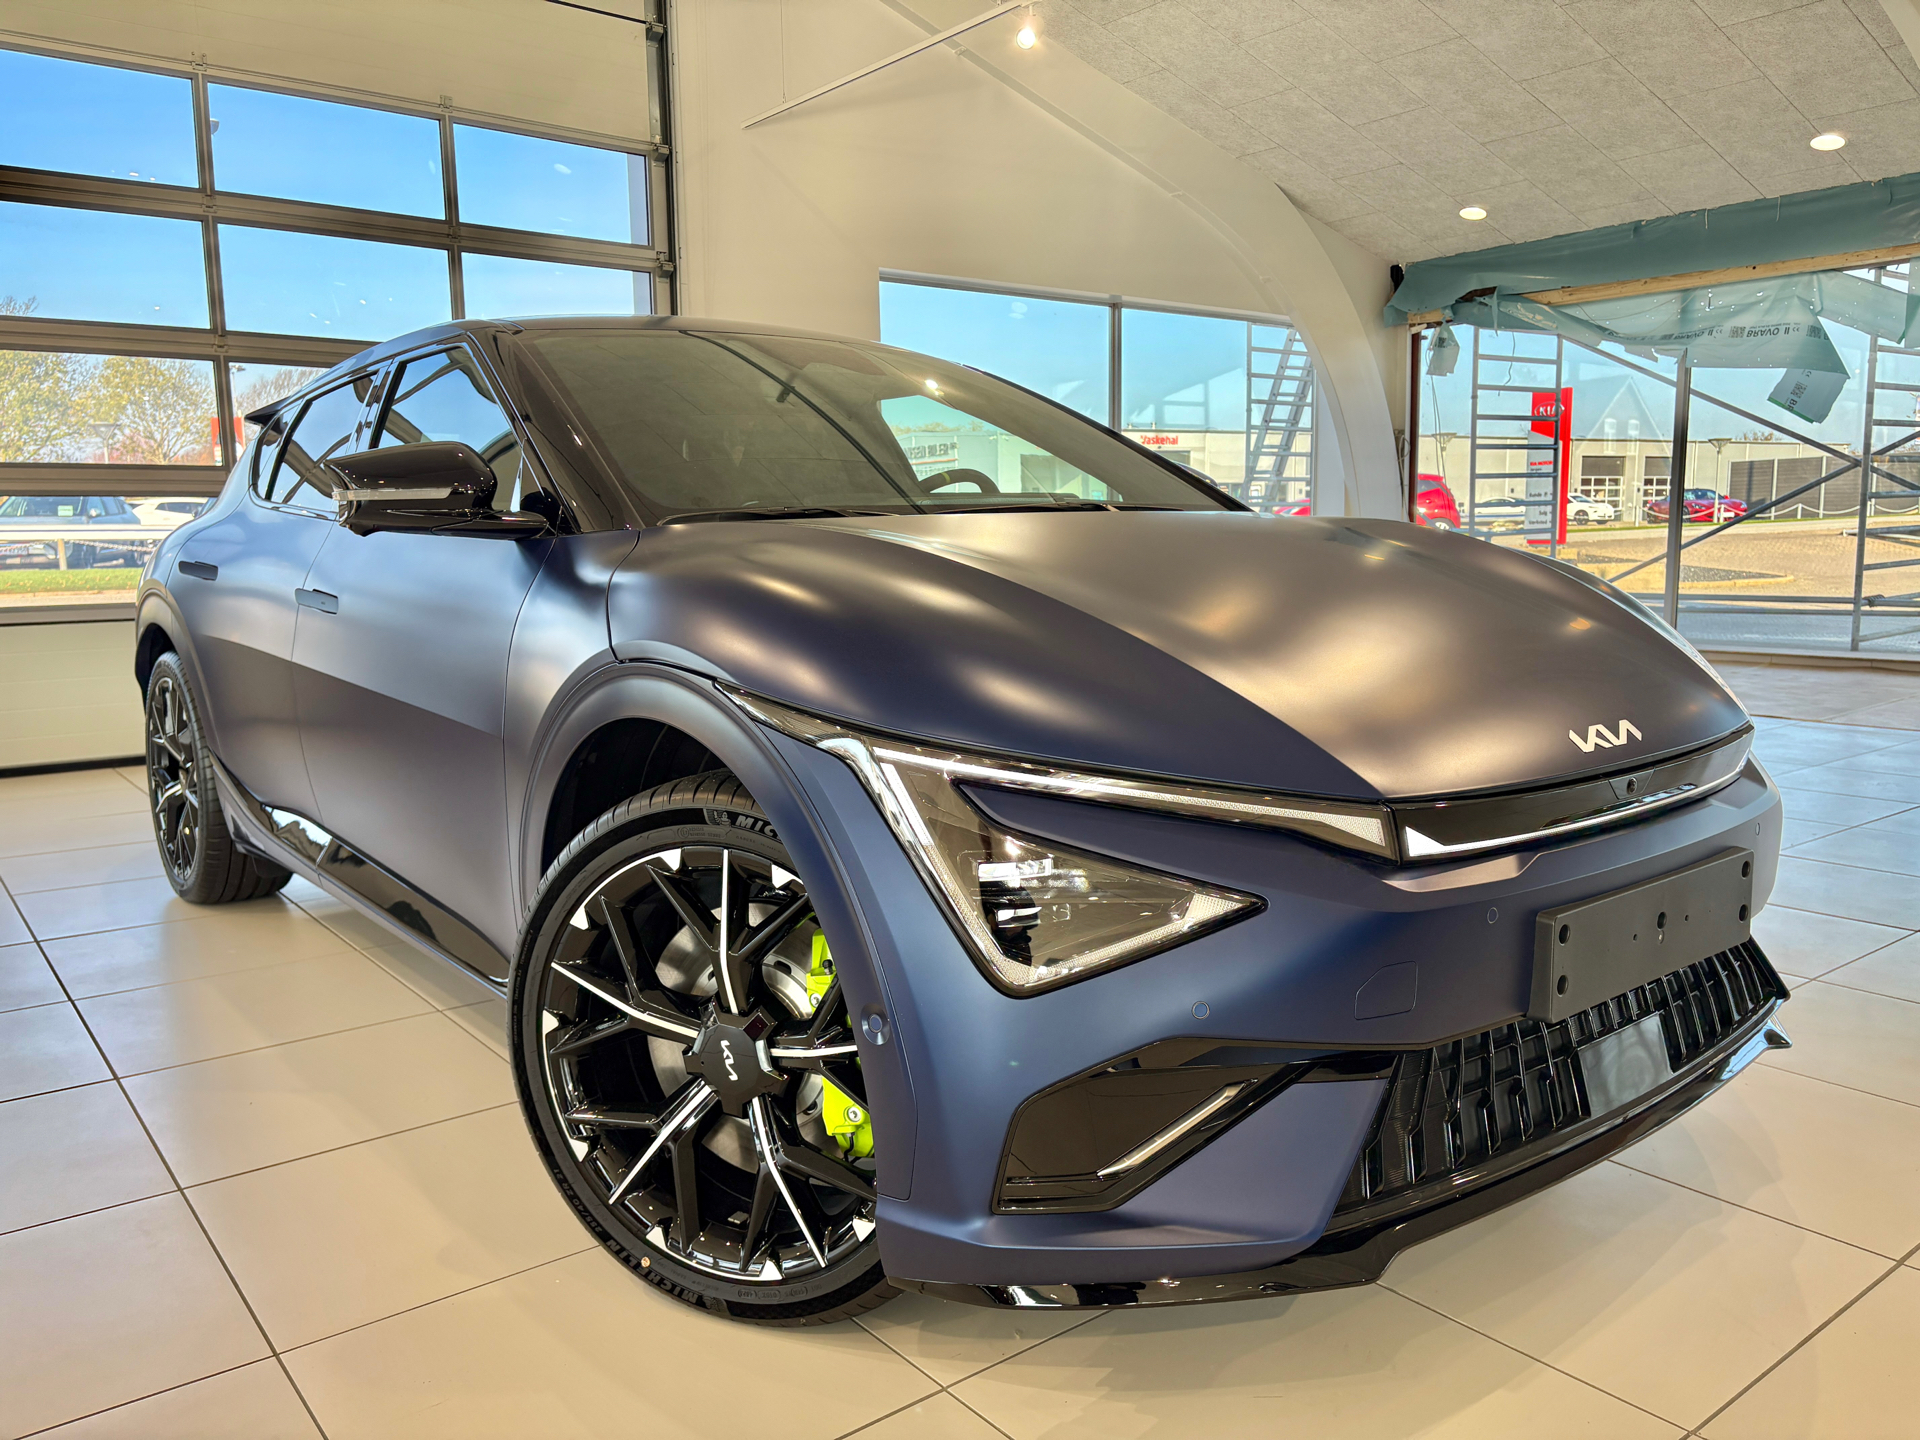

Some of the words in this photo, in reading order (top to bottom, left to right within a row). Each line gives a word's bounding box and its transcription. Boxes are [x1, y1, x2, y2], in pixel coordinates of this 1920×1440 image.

[1140, 434, 1179, 445] Vaskehal
[1569, 719, 1642, 753] KIA
[735, 814, 781, 839] MIC
[605, 1238, 700, 1304] MICHELIN
